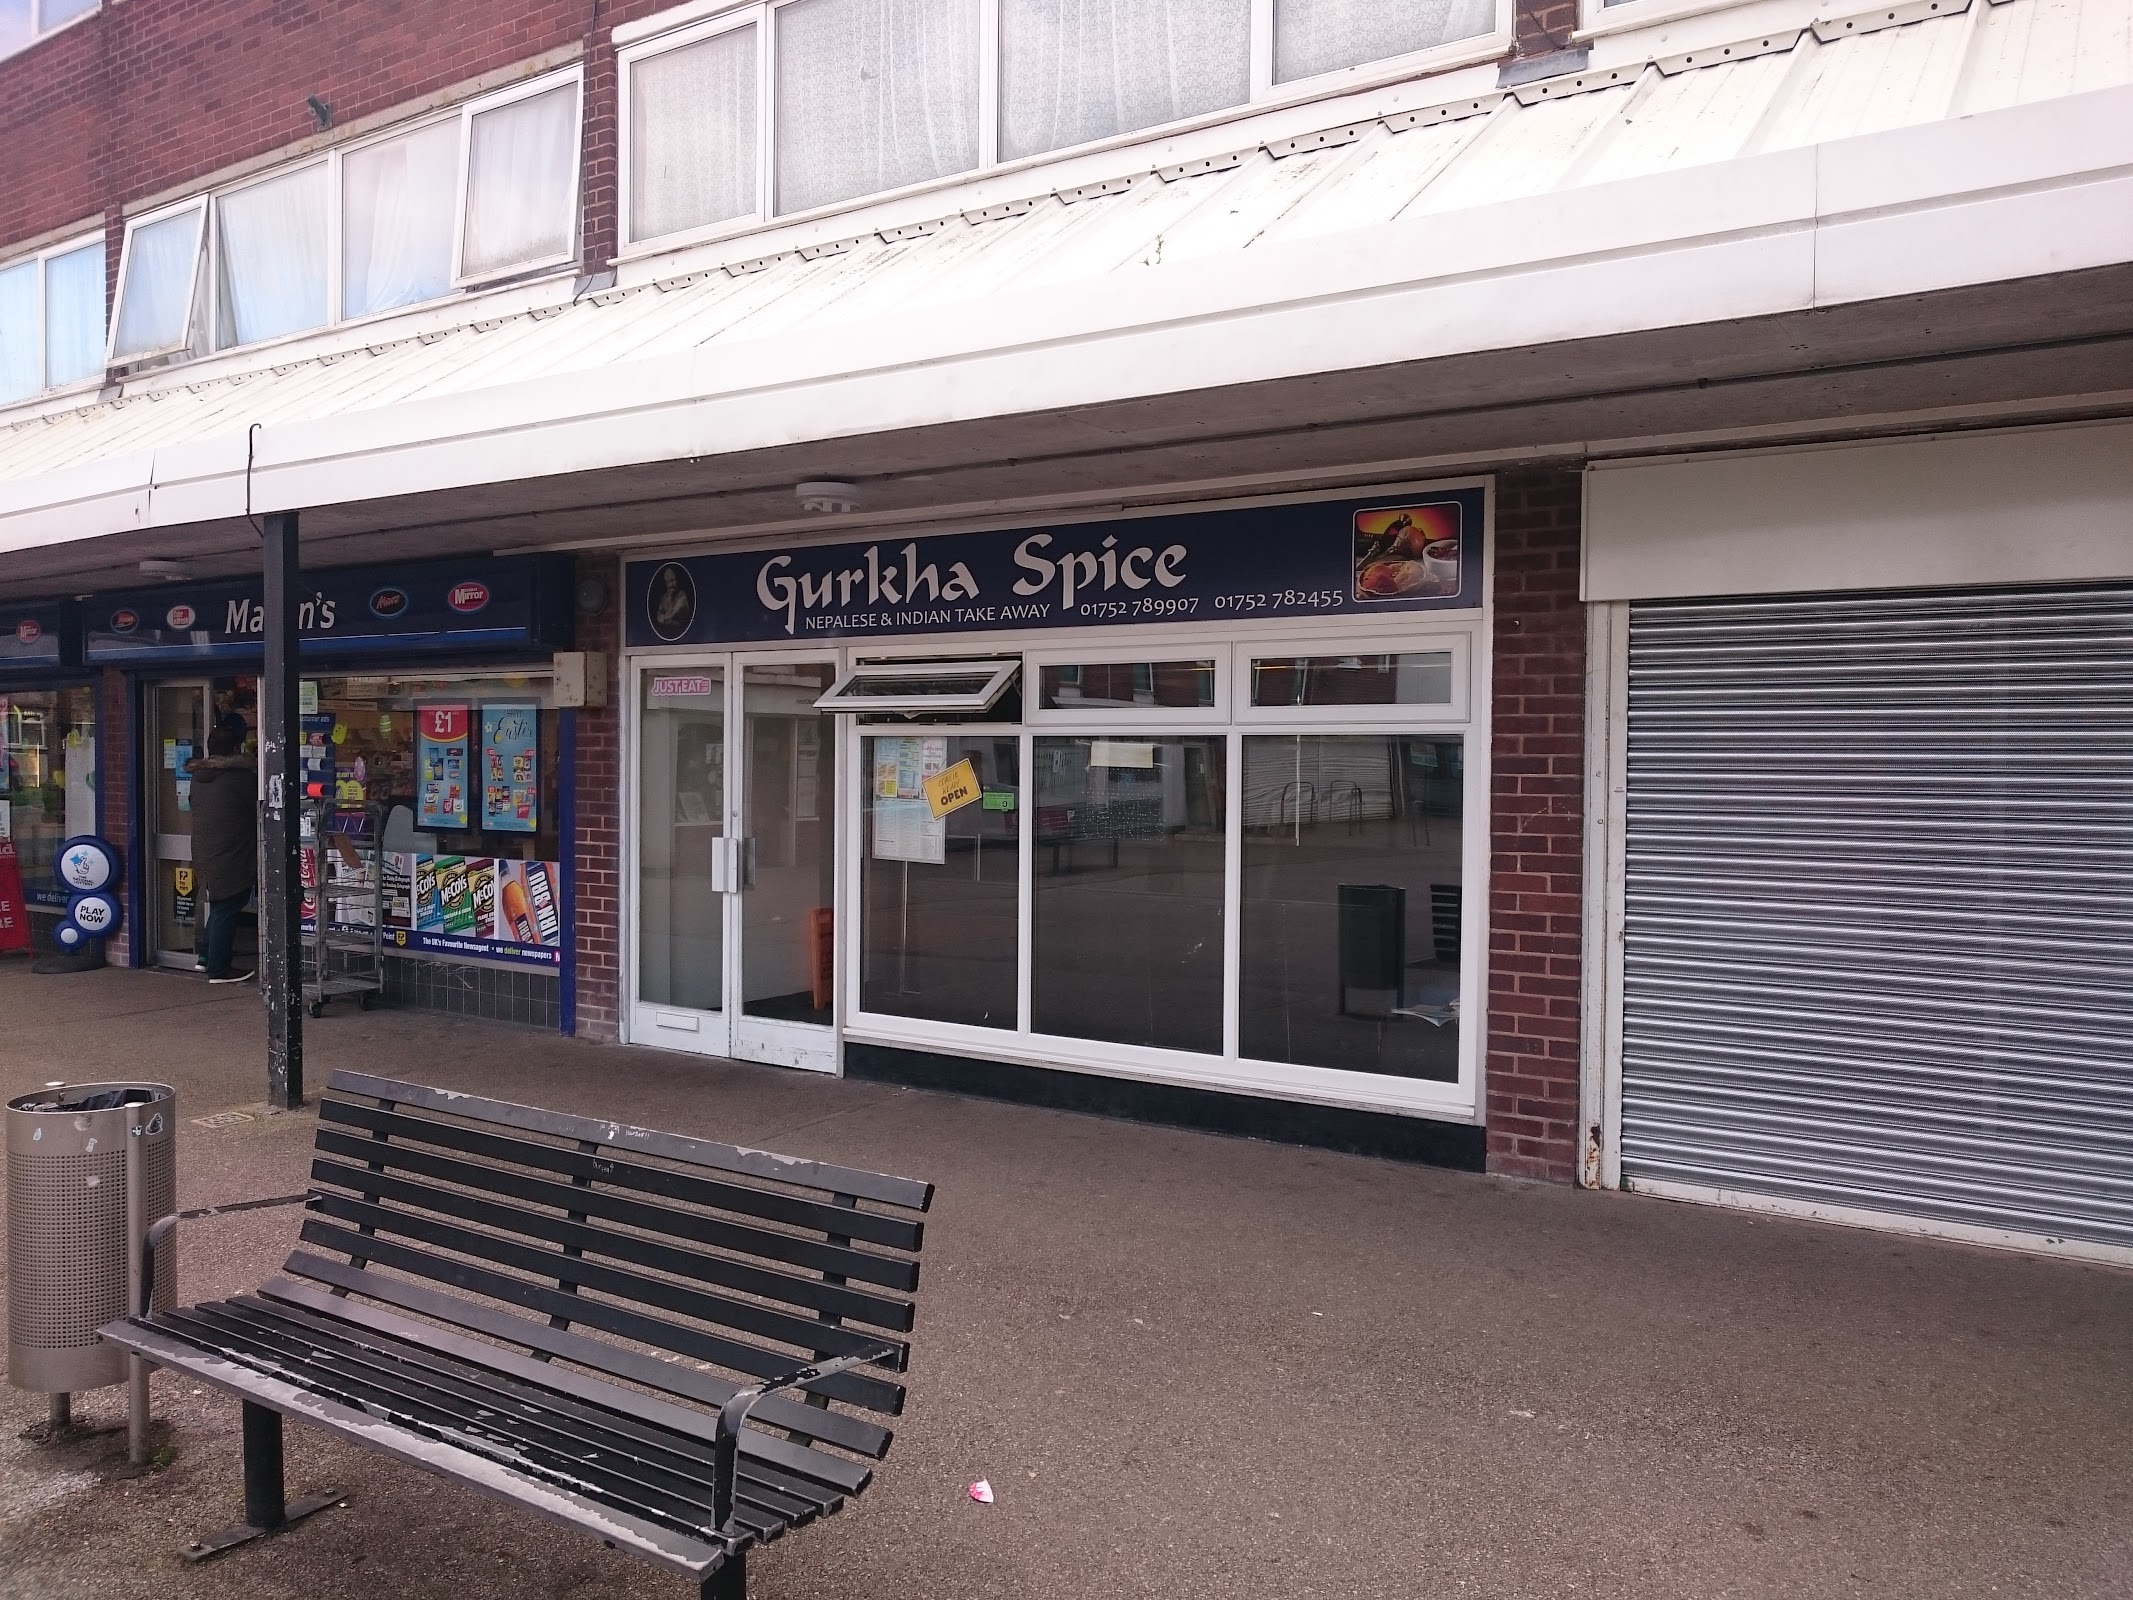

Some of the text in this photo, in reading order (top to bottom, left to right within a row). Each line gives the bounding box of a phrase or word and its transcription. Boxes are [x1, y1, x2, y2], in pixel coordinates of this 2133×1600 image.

[756, 533, 1187, 635] Gurkha Spice
[454, 588, 484, 605] Mirror
[1214, 589, 1344, 611] 01752 782455
[225, 591, 336, 634] Man's
[805, 603, 1051, 630] NEPALESE & INDIAN TAKE AWAY
[1080, 597, 1199, 618] 01752 789907
[654, 679, 702, 694] JUST EAT
[434, 710, 452, 733] £1
[940, 785, 969, 806] OPEN
[36, 892, 69, 903] we deliver
[79, 913, 104, 924] NOW
[80, 905, 106, 916] PLAY
[422, 936, 489, 953] The UK's Favourite Newsagent
[495, 946, 504, 954] we
[504, 946, 521, 956] deliver
[521, 949, 552, 961] newspapers
